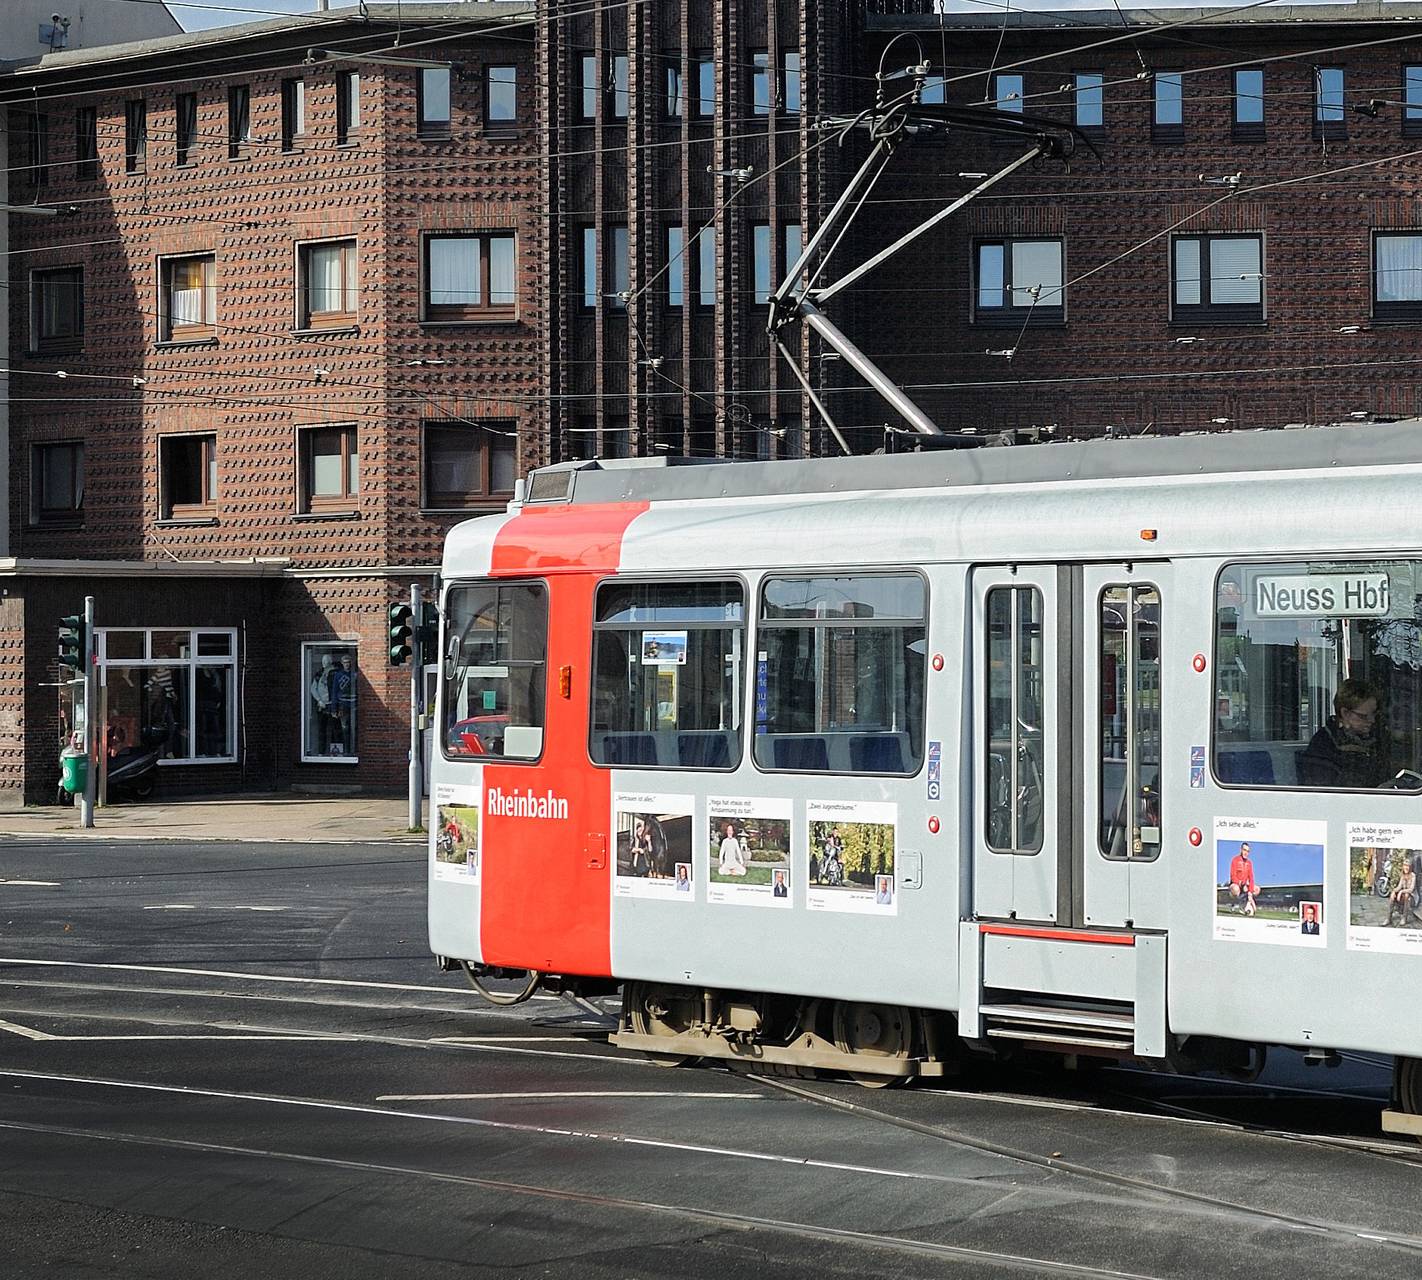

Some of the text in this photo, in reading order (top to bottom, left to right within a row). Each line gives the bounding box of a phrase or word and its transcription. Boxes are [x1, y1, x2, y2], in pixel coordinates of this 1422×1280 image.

[1259, 580, 1387, 611] Neuss Hbf
[488, 786, 568, 819] Rheinbahn
[1378, 828, 1392, 836] gern
